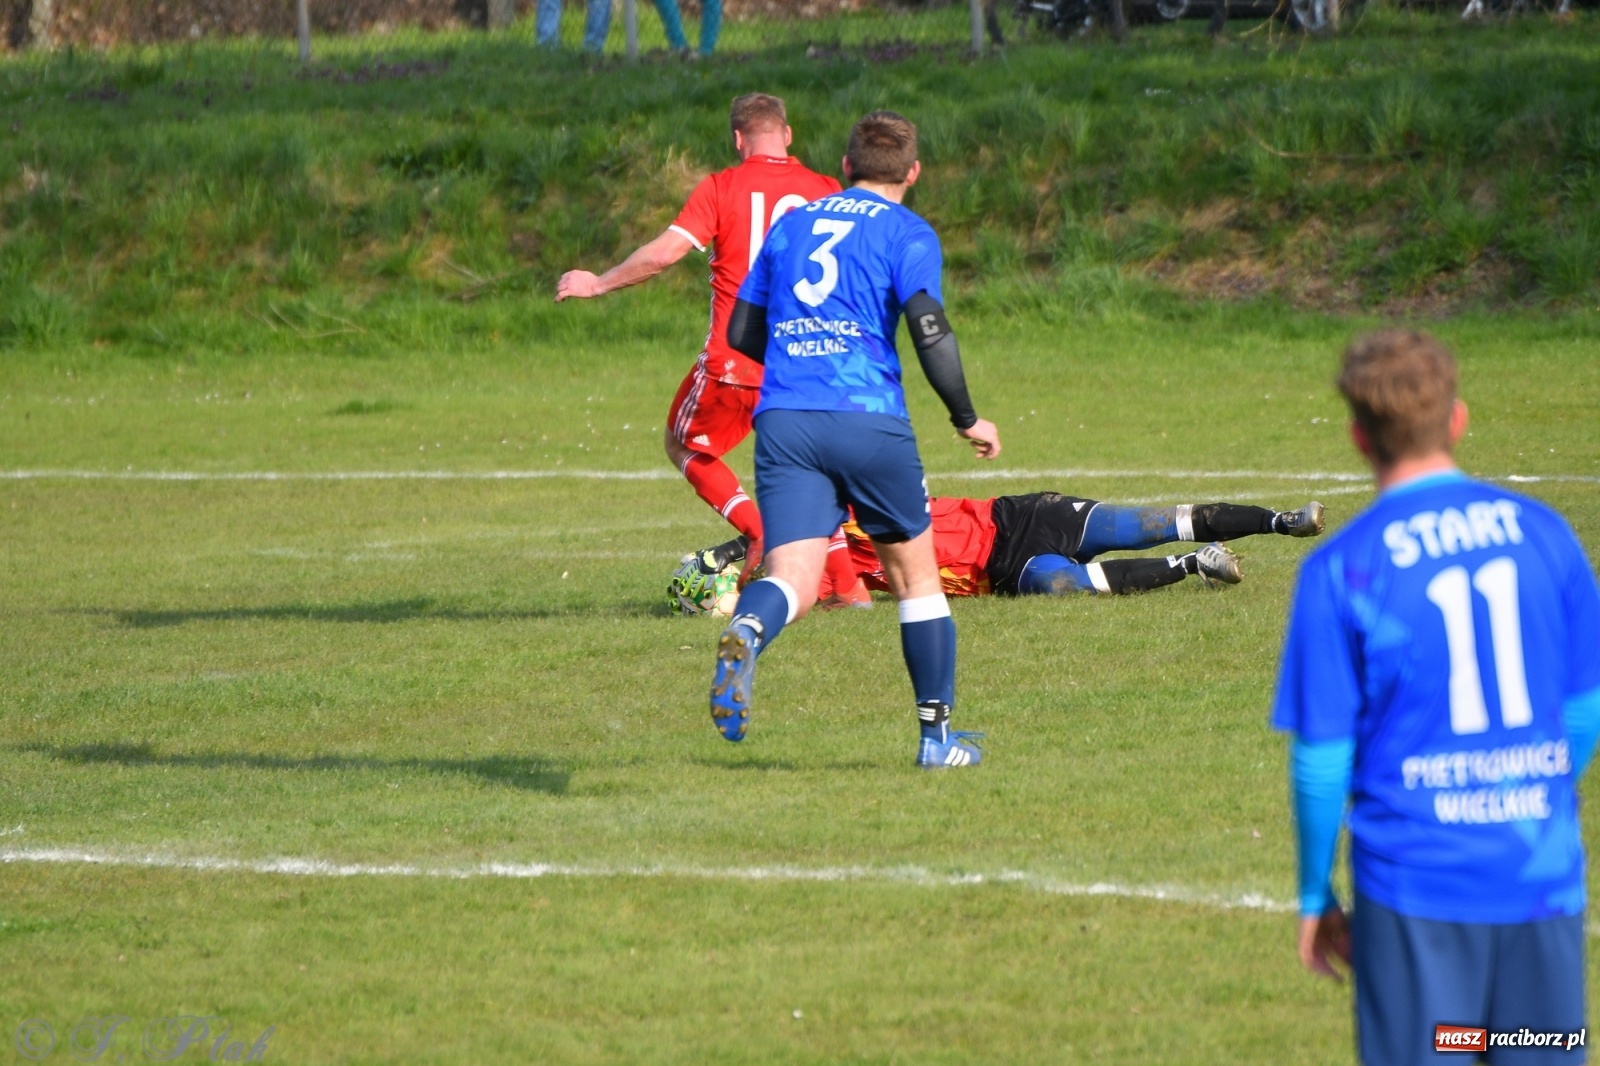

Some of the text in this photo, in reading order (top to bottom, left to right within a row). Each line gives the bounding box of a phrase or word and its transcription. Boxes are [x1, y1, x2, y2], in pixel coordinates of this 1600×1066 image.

[750, 191, 808, 272] 1
[805, 196, 890, 218] START
[793, 218, 855, 307] 3
[787, 337, 849, 357] WIELKIE
[919, 314, 939, 335] C
[1383, 499, 1524, 569] START
[1426, 556, 1533, 735] 11
[1434, 783, 1551, 824] WIELKIE
